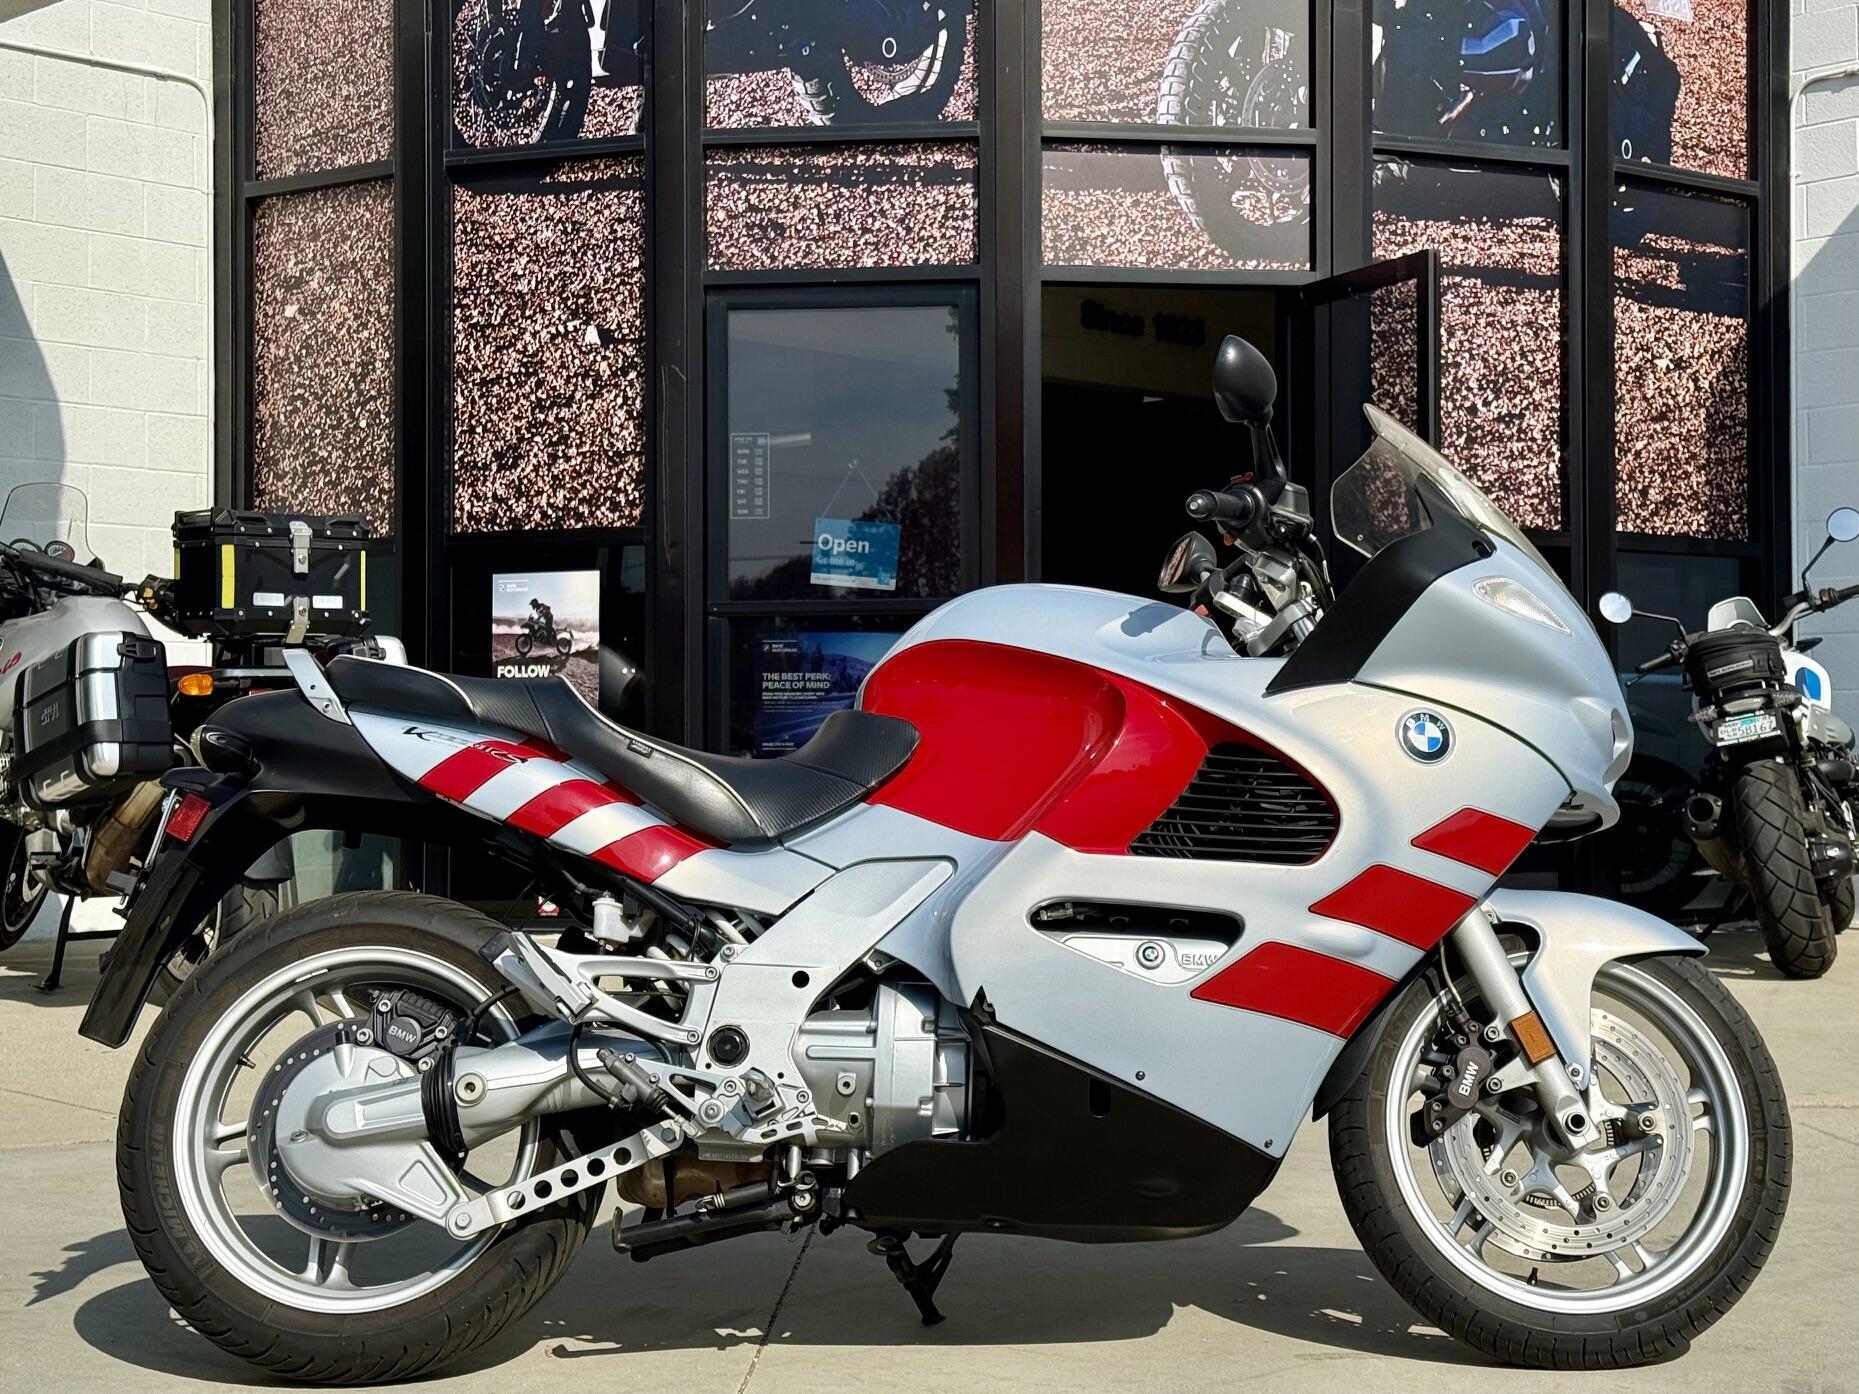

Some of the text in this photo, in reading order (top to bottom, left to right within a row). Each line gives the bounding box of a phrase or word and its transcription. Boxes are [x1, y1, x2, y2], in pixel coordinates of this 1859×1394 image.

[817, 533, 870, 555] Open
[496, 664, 551, 679] FOLLOW
[762, 672, 832, 681] THE BEST PERK:
[762, 681, 831, 690] PEACE OF MIND
[1405, 713, 1446, 731] BMW
[1181, 953, 1219, 967] BMW
[388, 1025, 417, 1043] BMW
[1458, 1060, 1479, 1097] BMW
